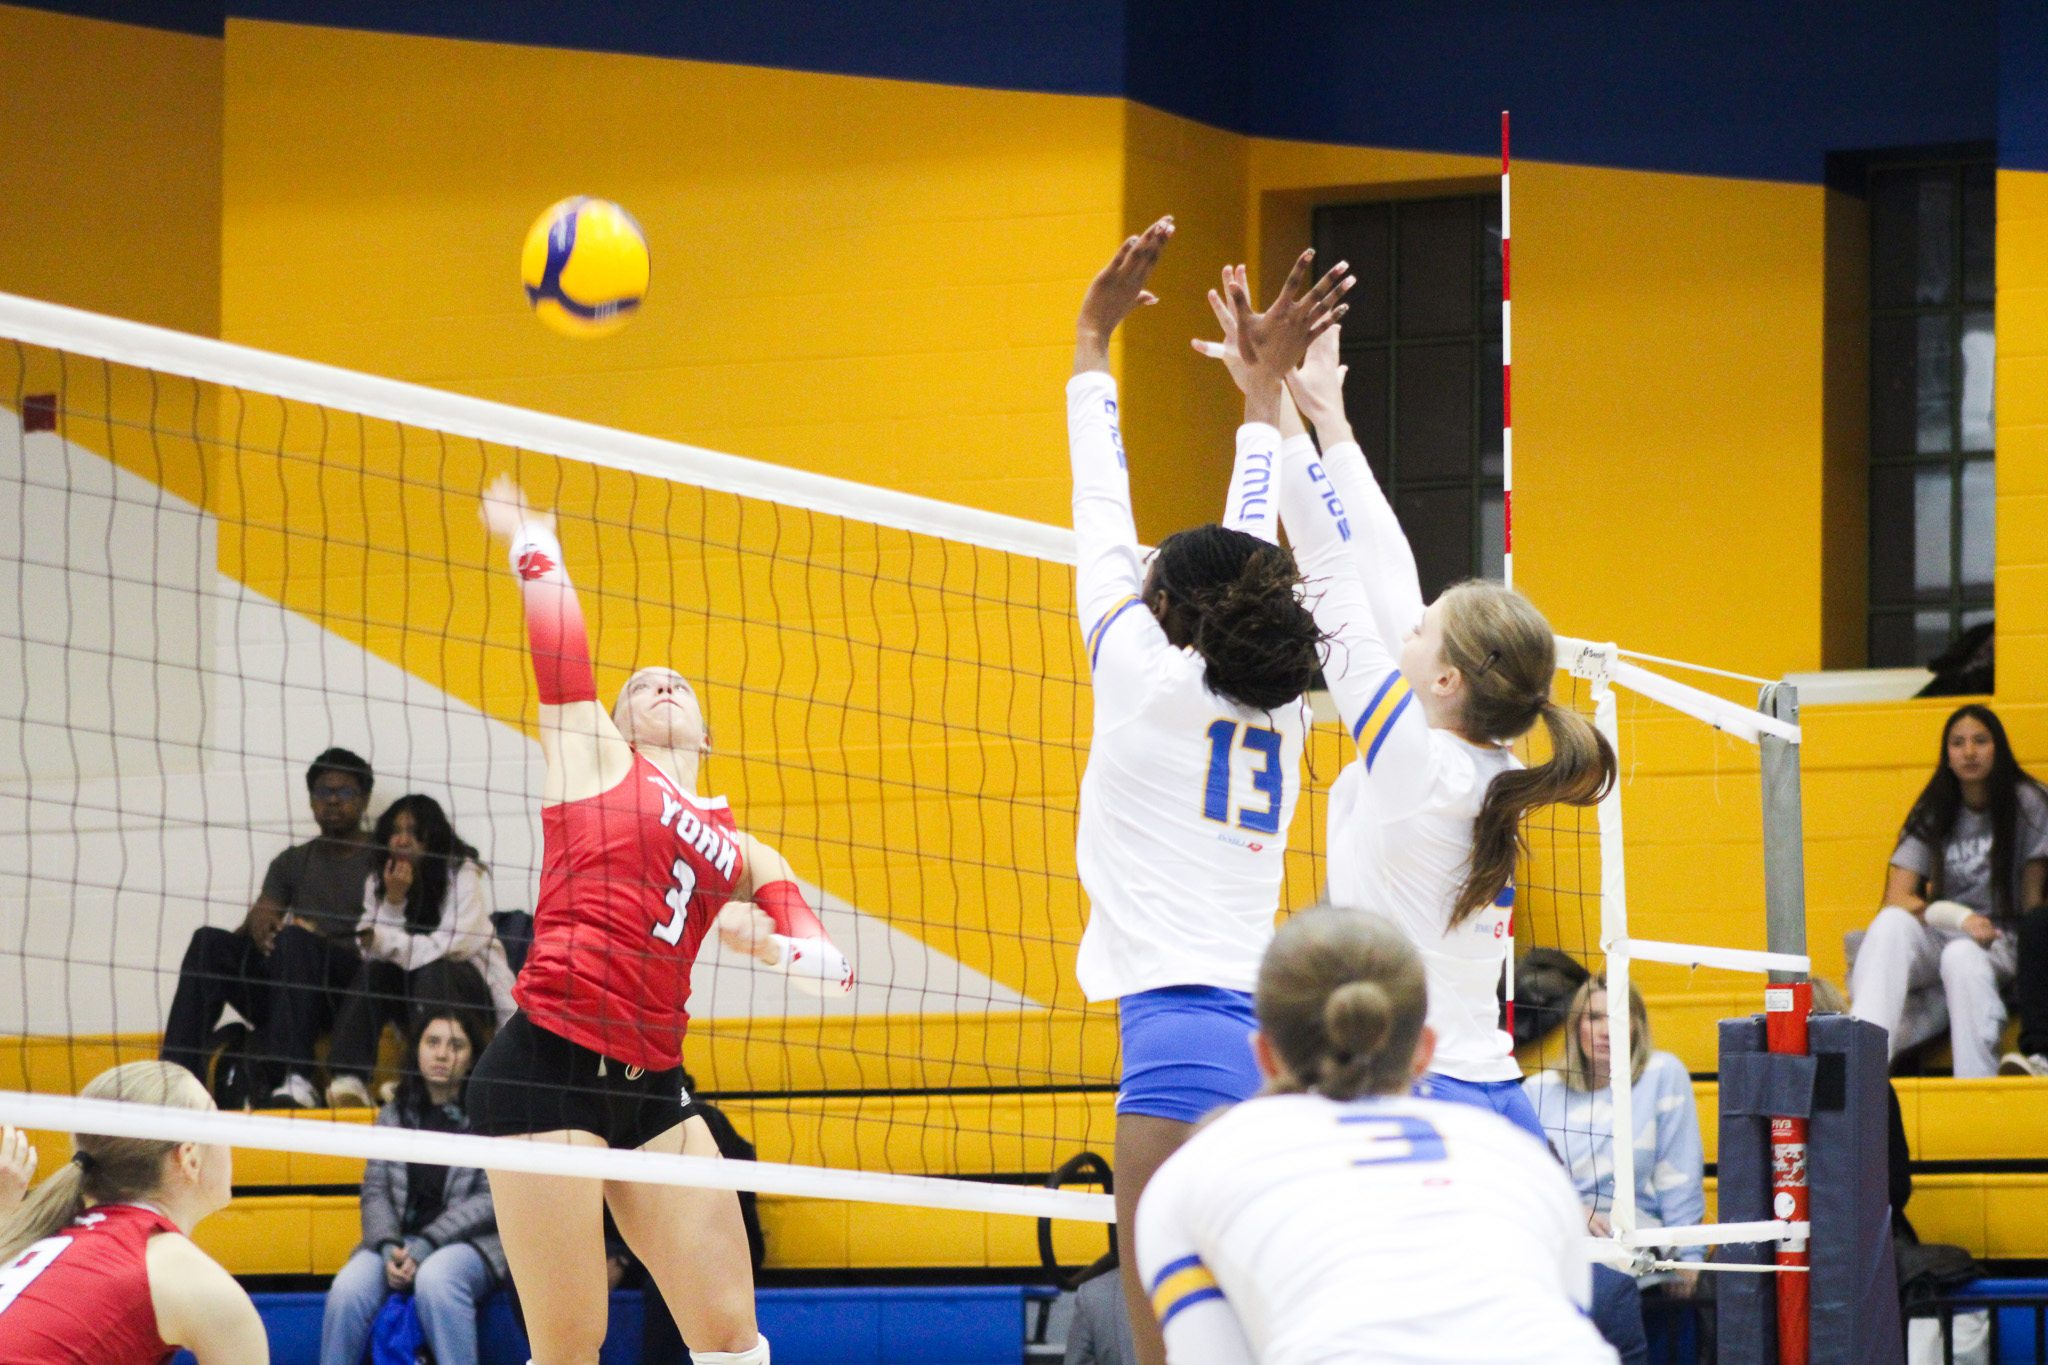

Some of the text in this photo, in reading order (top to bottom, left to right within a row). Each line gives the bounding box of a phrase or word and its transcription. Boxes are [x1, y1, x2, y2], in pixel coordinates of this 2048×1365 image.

[1201, 717, 1284, 836] 13
[660, 791, 738, 882] YORK
[652, 857, 696, 947] 3
[1336, 1115, 1450, 1167] 3
